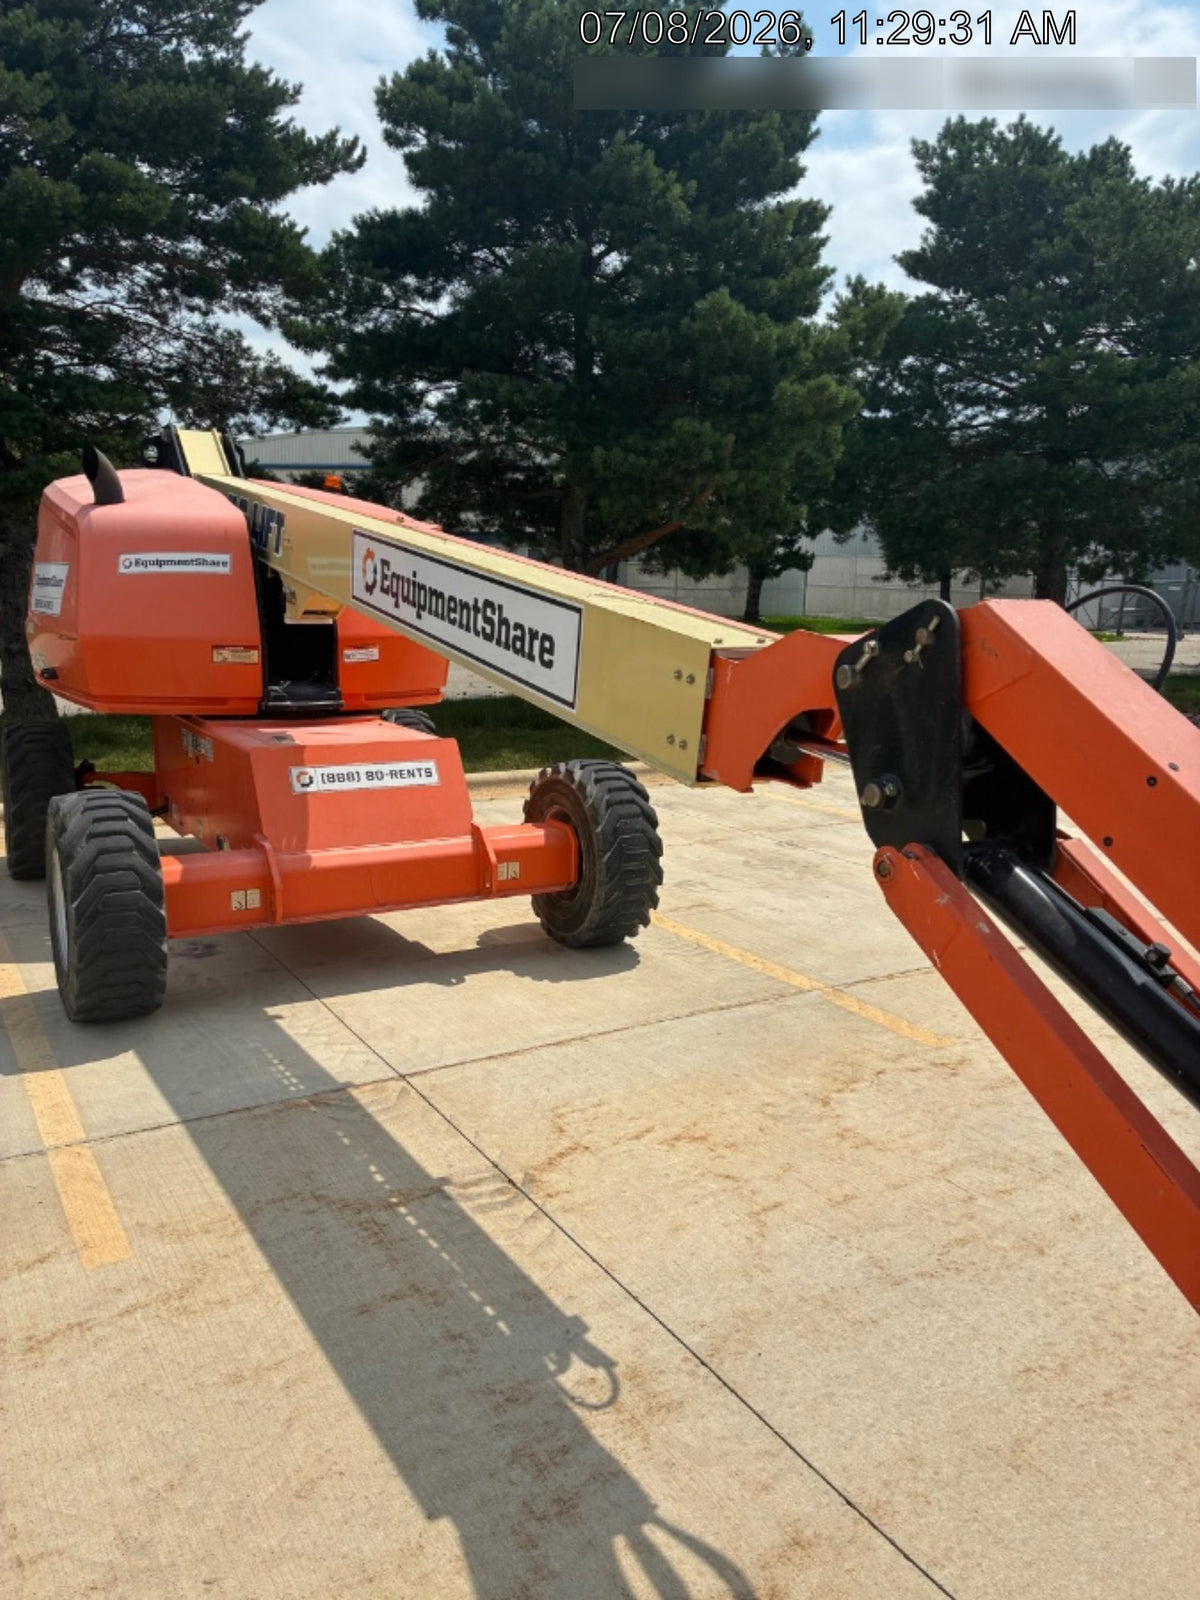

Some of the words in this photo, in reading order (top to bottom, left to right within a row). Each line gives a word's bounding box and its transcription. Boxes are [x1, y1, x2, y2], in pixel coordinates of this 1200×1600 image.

[134, 558, 228, 569] EquipmentShare
[379, 557, 556, 671] EquipmentShare
[365, 767, 433, 781] 80-RENTS
